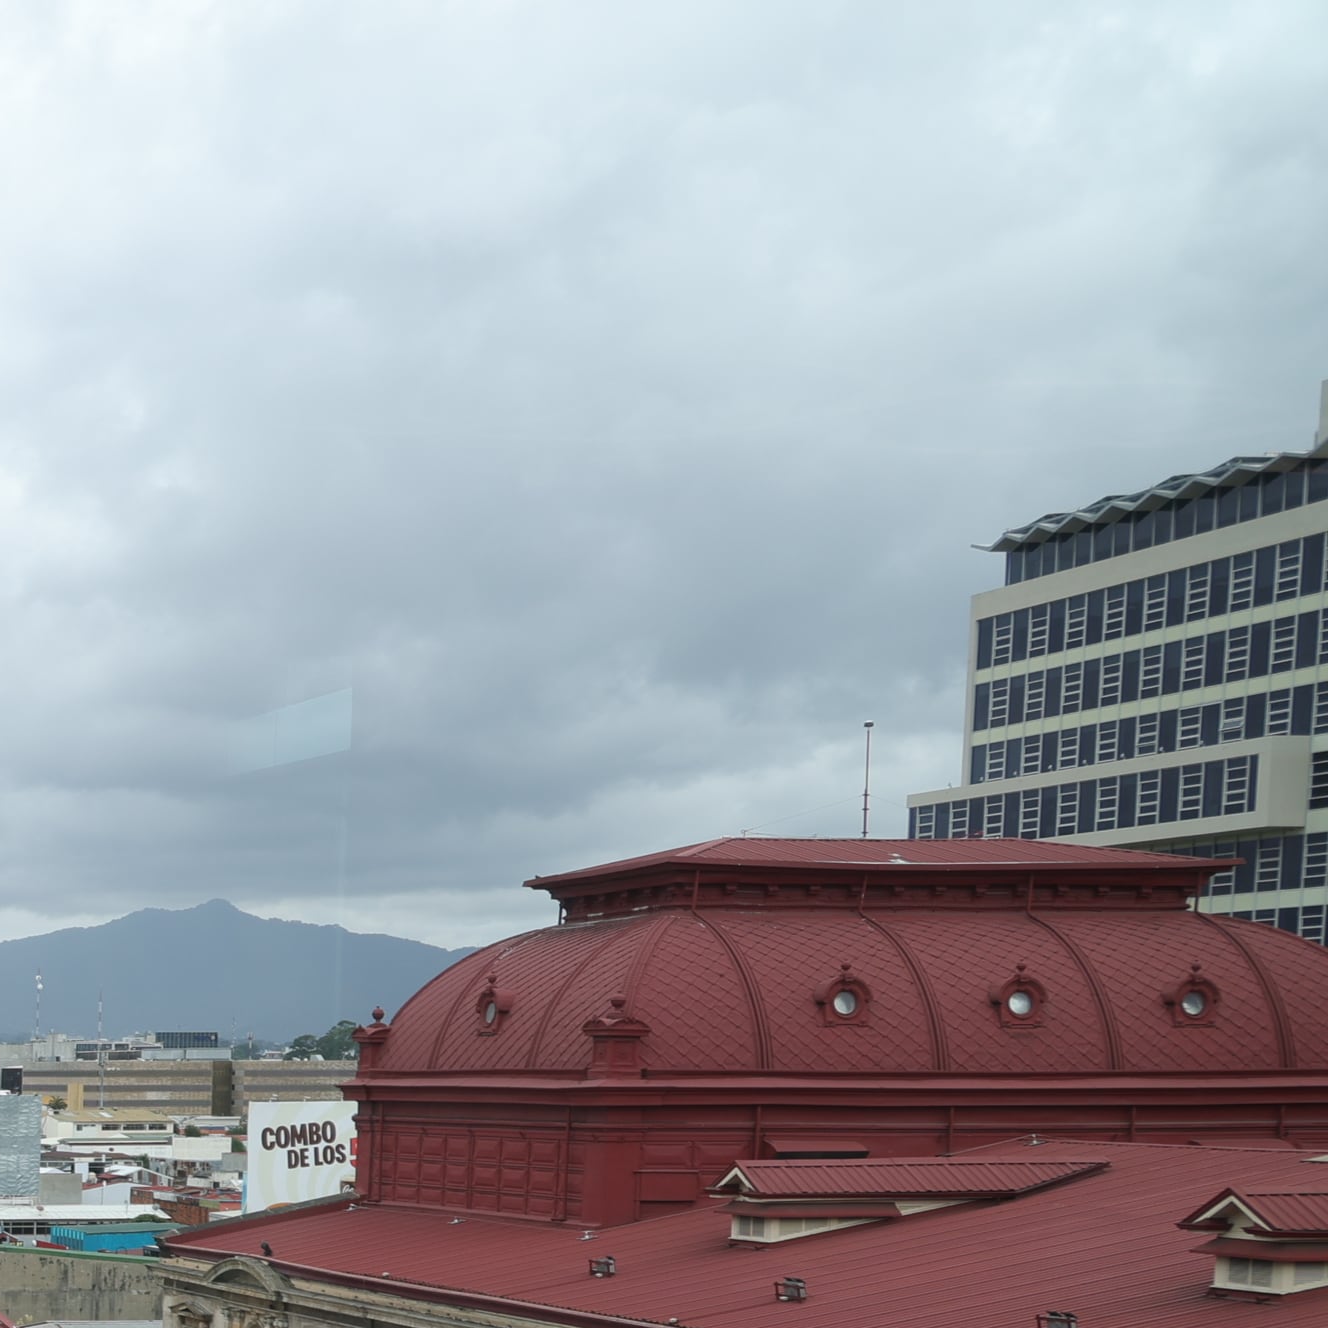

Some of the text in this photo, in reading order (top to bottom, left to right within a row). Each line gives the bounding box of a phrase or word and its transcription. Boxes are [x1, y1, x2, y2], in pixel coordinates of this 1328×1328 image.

[261, 1121, 336, 1151] COMBO
[287, 1143, 347, 1169] DE LOS
